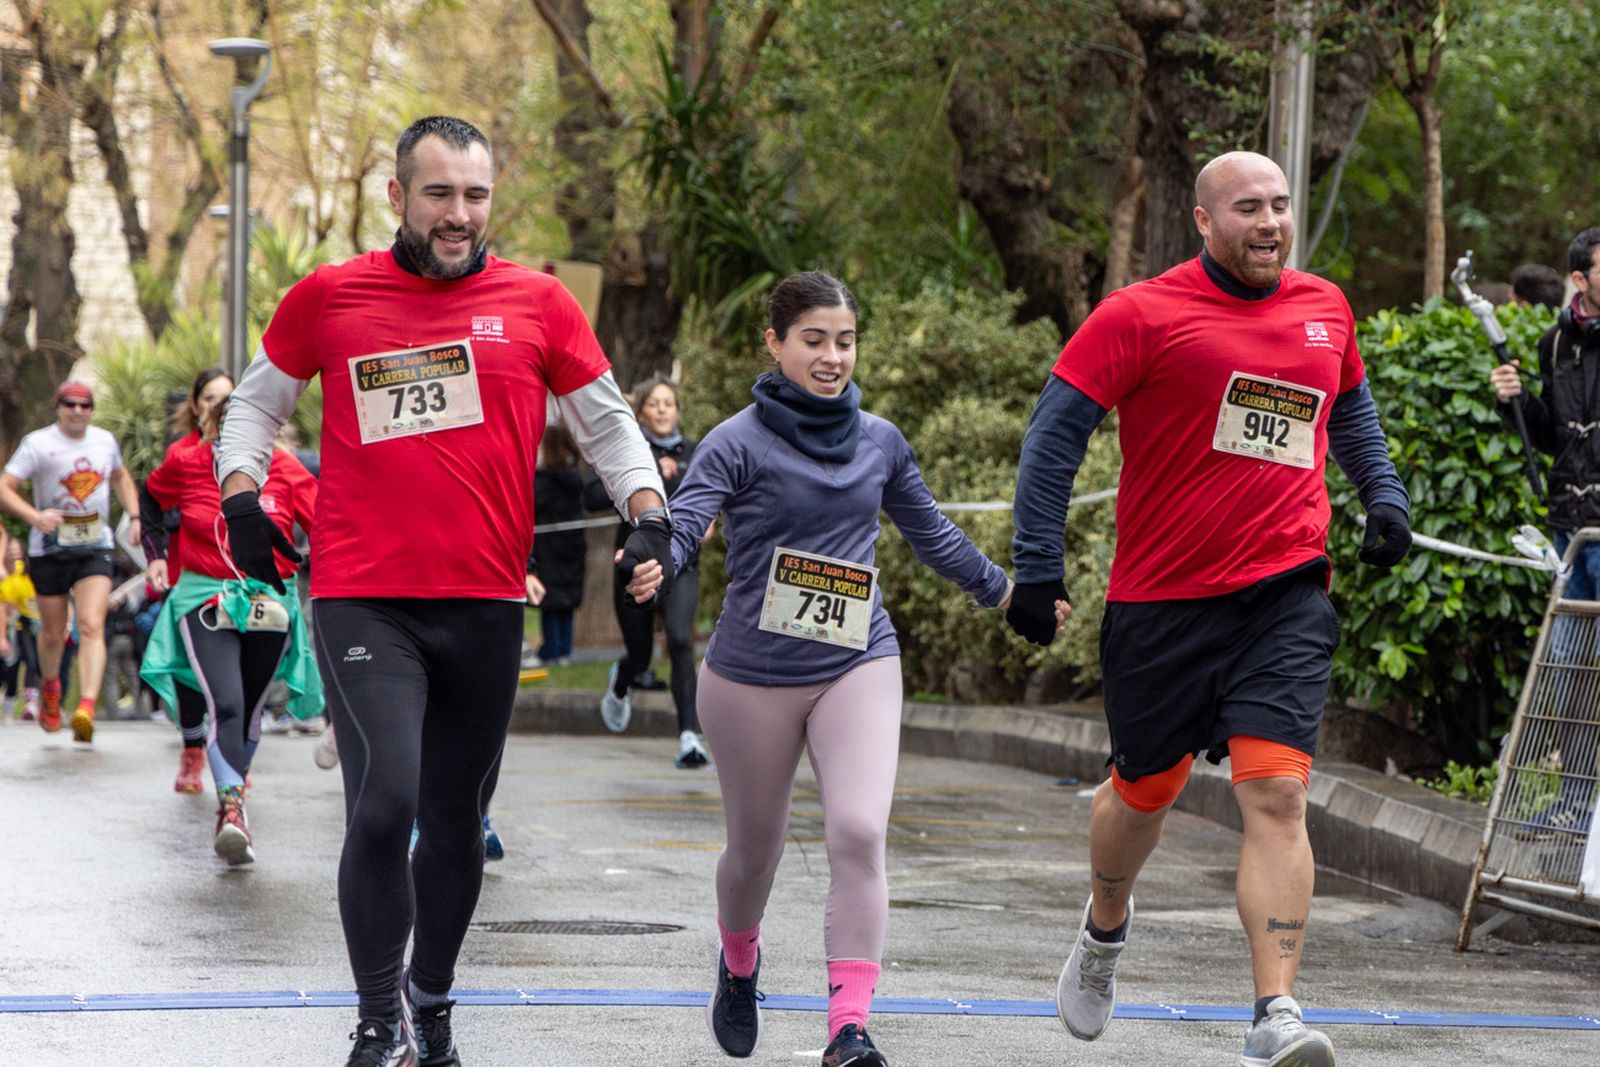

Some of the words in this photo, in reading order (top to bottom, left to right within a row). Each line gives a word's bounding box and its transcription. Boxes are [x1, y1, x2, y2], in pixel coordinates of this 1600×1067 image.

[361, 376, 369, 389] V
[371, 369, 417, 387] CARRERA
[420, 360, 466, 378] POPULAR
[362, 362, 378, 374] IES
[381, 360, 400, 370] San
[403, 356, 427, 367] Juan
[429, 348, 460, 362] Bosco
[388, 382, 447, 419] 733
[1231, 390, 1238, 402] V
[1238, 393, 1275, 411] CARRERA
[1277, 401, 1312, 420] POPULAR
[1237, 380, 1250, 390] IES
[1251, 383, 1266, 394] San
[1267, 387, 1287, 399] Juan
[1288, 391, 1313, 405] Bosco
[1243, 412, 1290, 448] 942
[780, 568, 787, 581] V
[789, 571, 831, 590] CARRERA
[833, 580, 868, 598] POPULAR
[784, 557, 800, 569] IES
[802, 560, 820, 573] San
[822, 565, 844, 577] Juan
[844, 569, 868, 583] Bosco
[795, 590, 847, 629] 734
